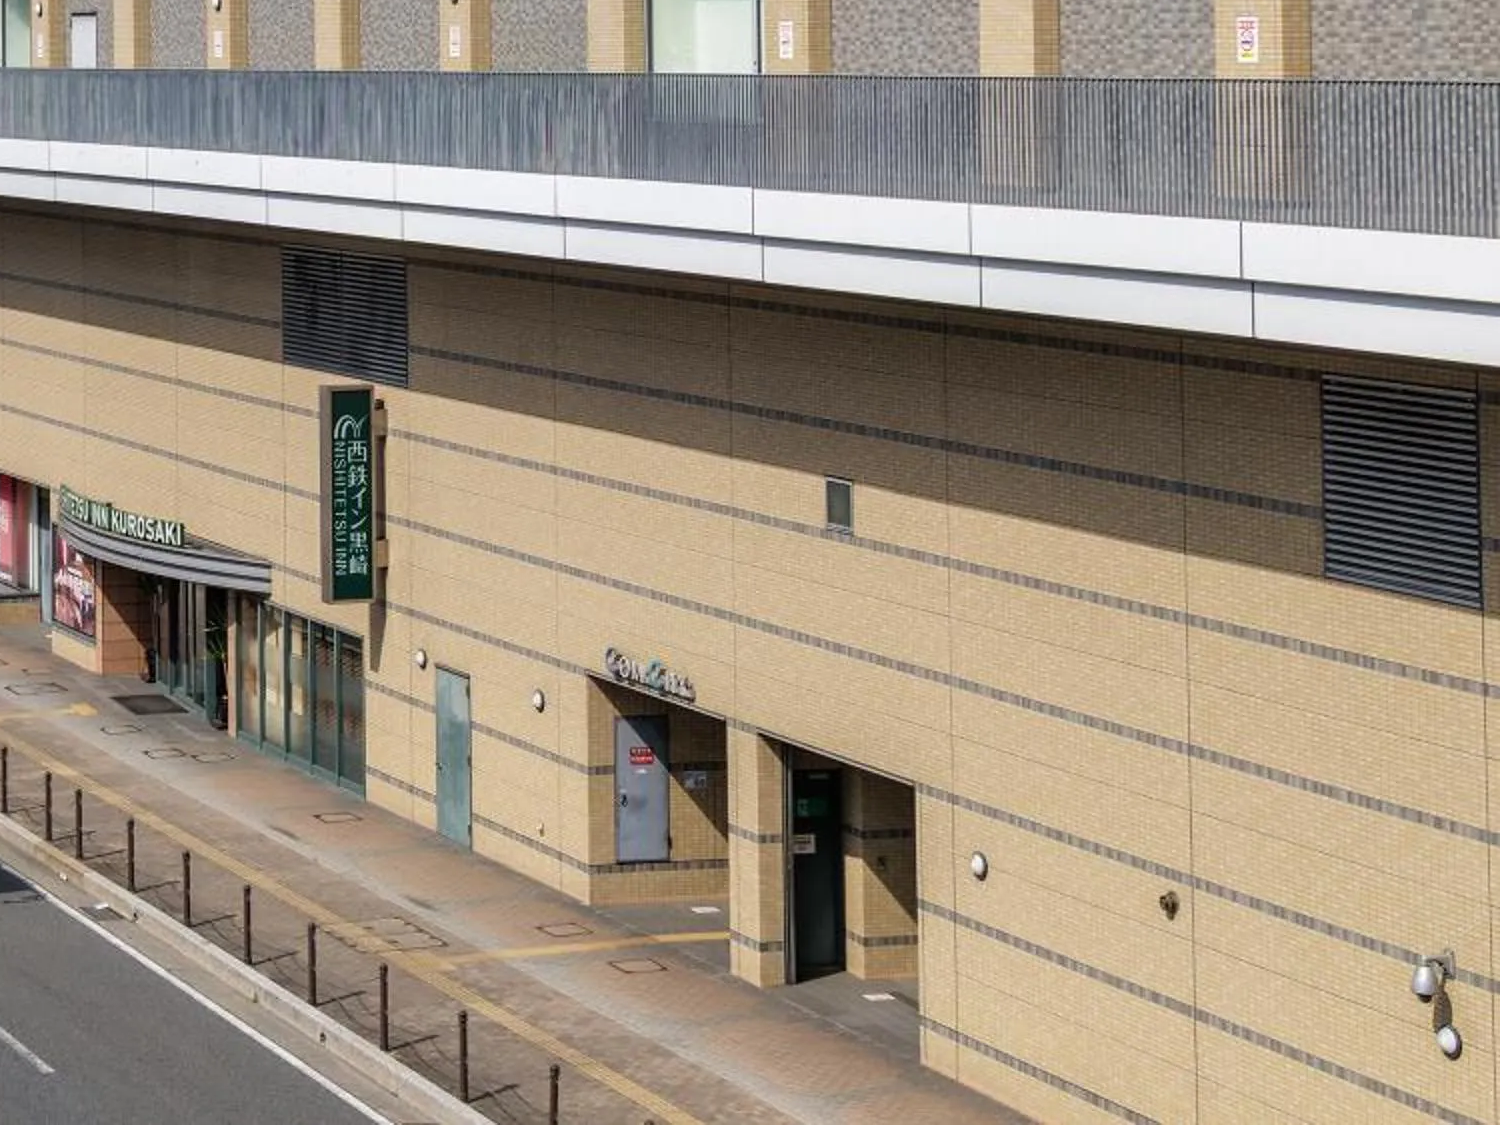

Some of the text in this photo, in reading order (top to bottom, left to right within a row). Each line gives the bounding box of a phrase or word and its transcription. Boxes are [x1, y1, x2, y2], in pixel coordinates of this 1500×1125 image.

[111, 508, 182, 546] KUROSAKI
[333, 441, 348, 576] NISHITETSU INN
[347, 439, 368, 576] 西鉄イン黒崎
